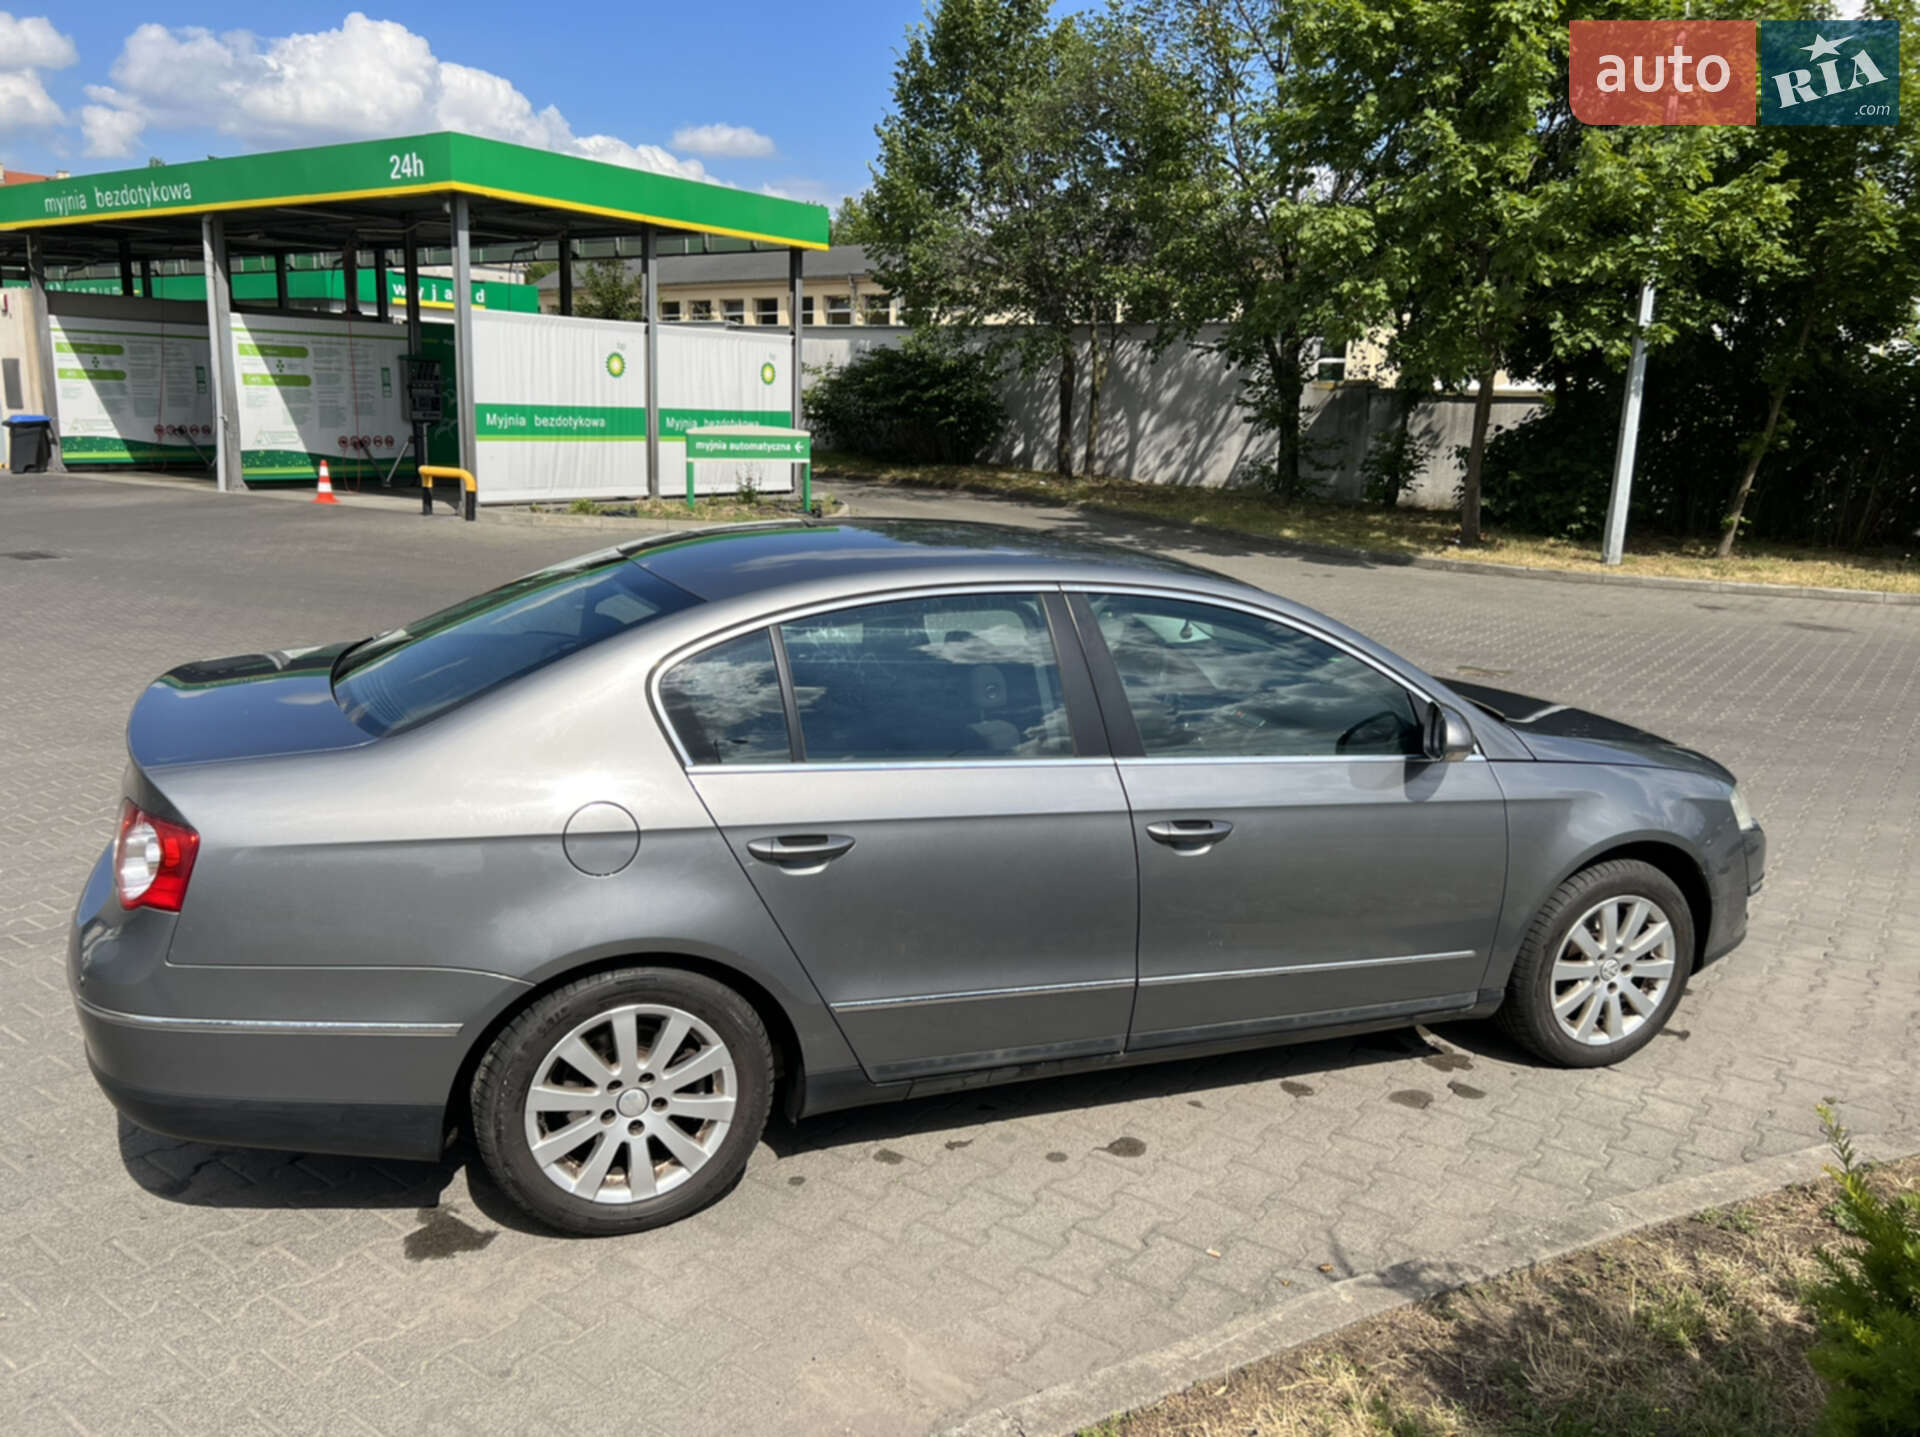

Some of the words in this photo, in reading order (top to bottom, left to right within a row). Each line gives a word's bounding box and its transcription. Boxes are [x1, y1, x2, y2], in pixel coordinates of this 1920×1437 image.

[390, 152, 424, 179] 24h
[44, 189, 87, 216] myjnia
[94, 181, 192, 208] bezdotykowa
[486, 413, 526, 429] Myjnia
[534, 414, 606, 430] bezdotykowa
[695, 440, 727, 452] myjnia
[729, 440, 791, 453] automatyczna
